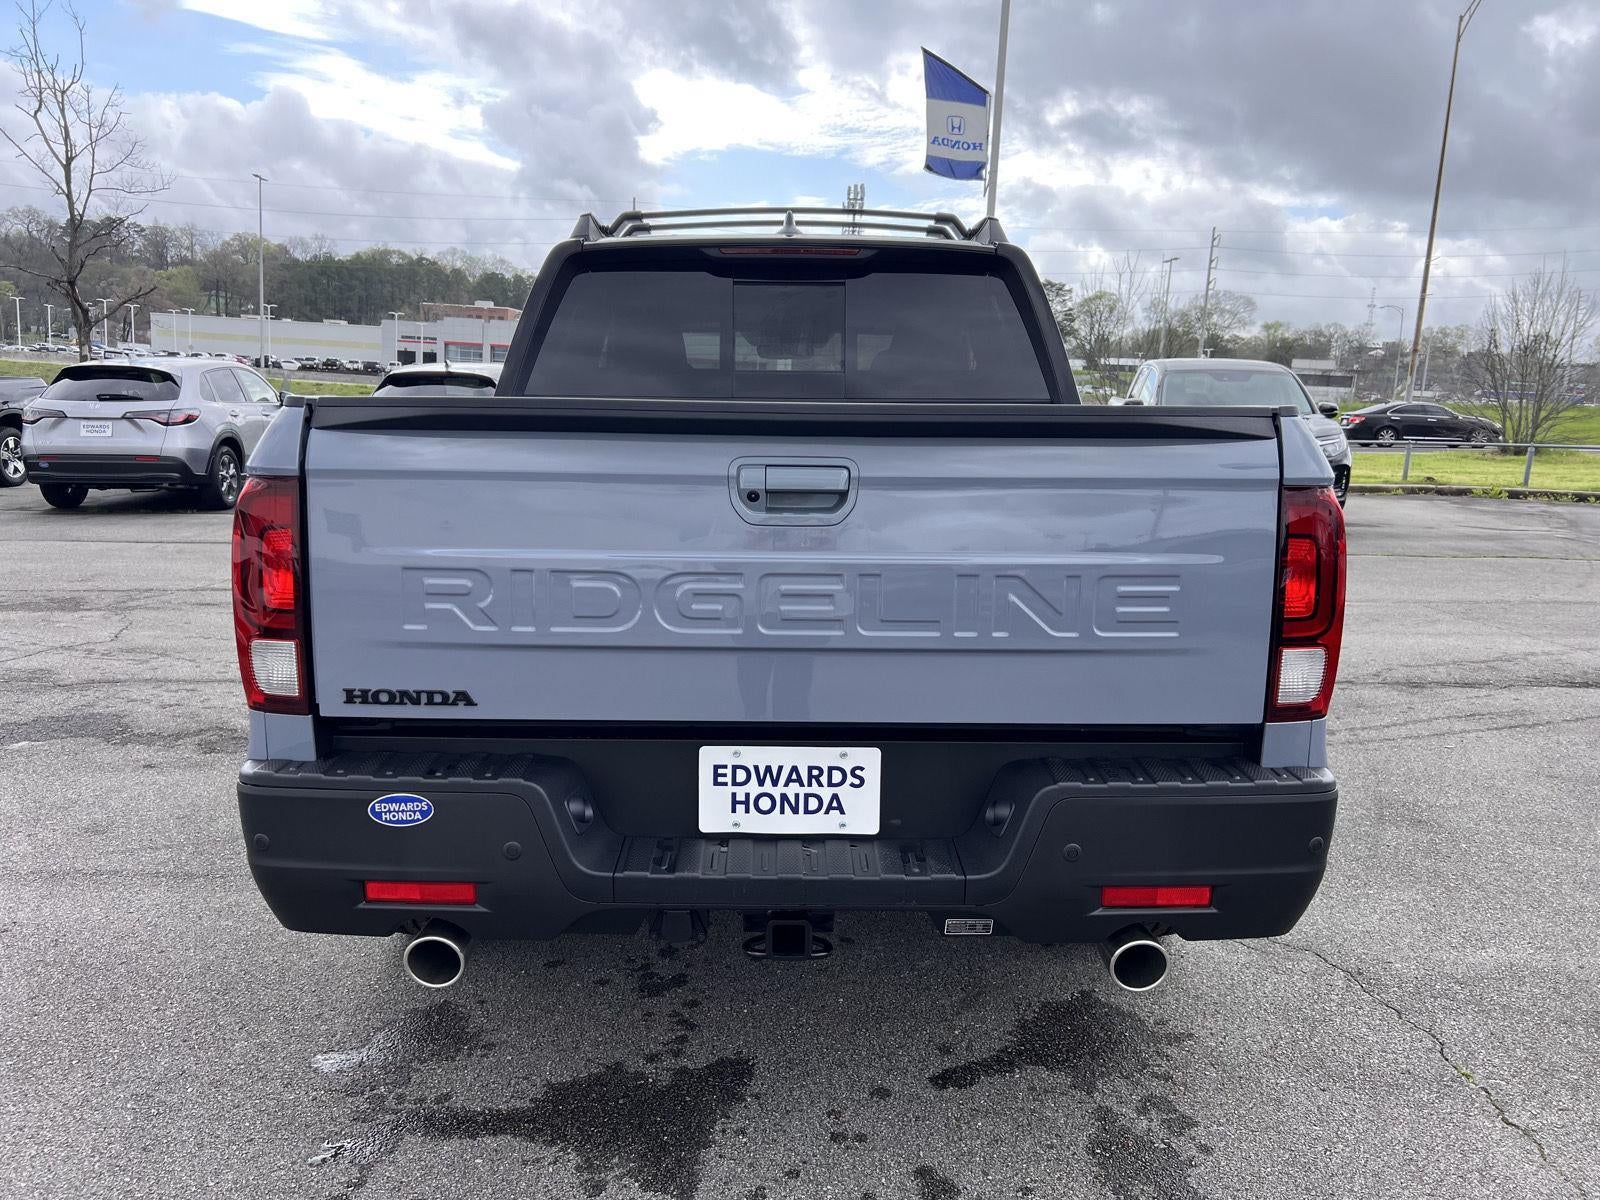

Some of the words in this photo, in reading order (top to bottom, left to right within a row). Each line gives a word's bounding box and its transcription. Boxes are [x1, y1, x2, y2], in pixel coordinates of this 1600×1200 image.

[402, 567, 1181, 638] RIDGELINE
[342, 687, 478, 706] HONDA
[712, 764, 866, 788] EDWARDS
[374, 802, 428, 812] EDWARDS
[730, 792, 846, 815] HONDA
[381, 812, 422, 821] HONDA
